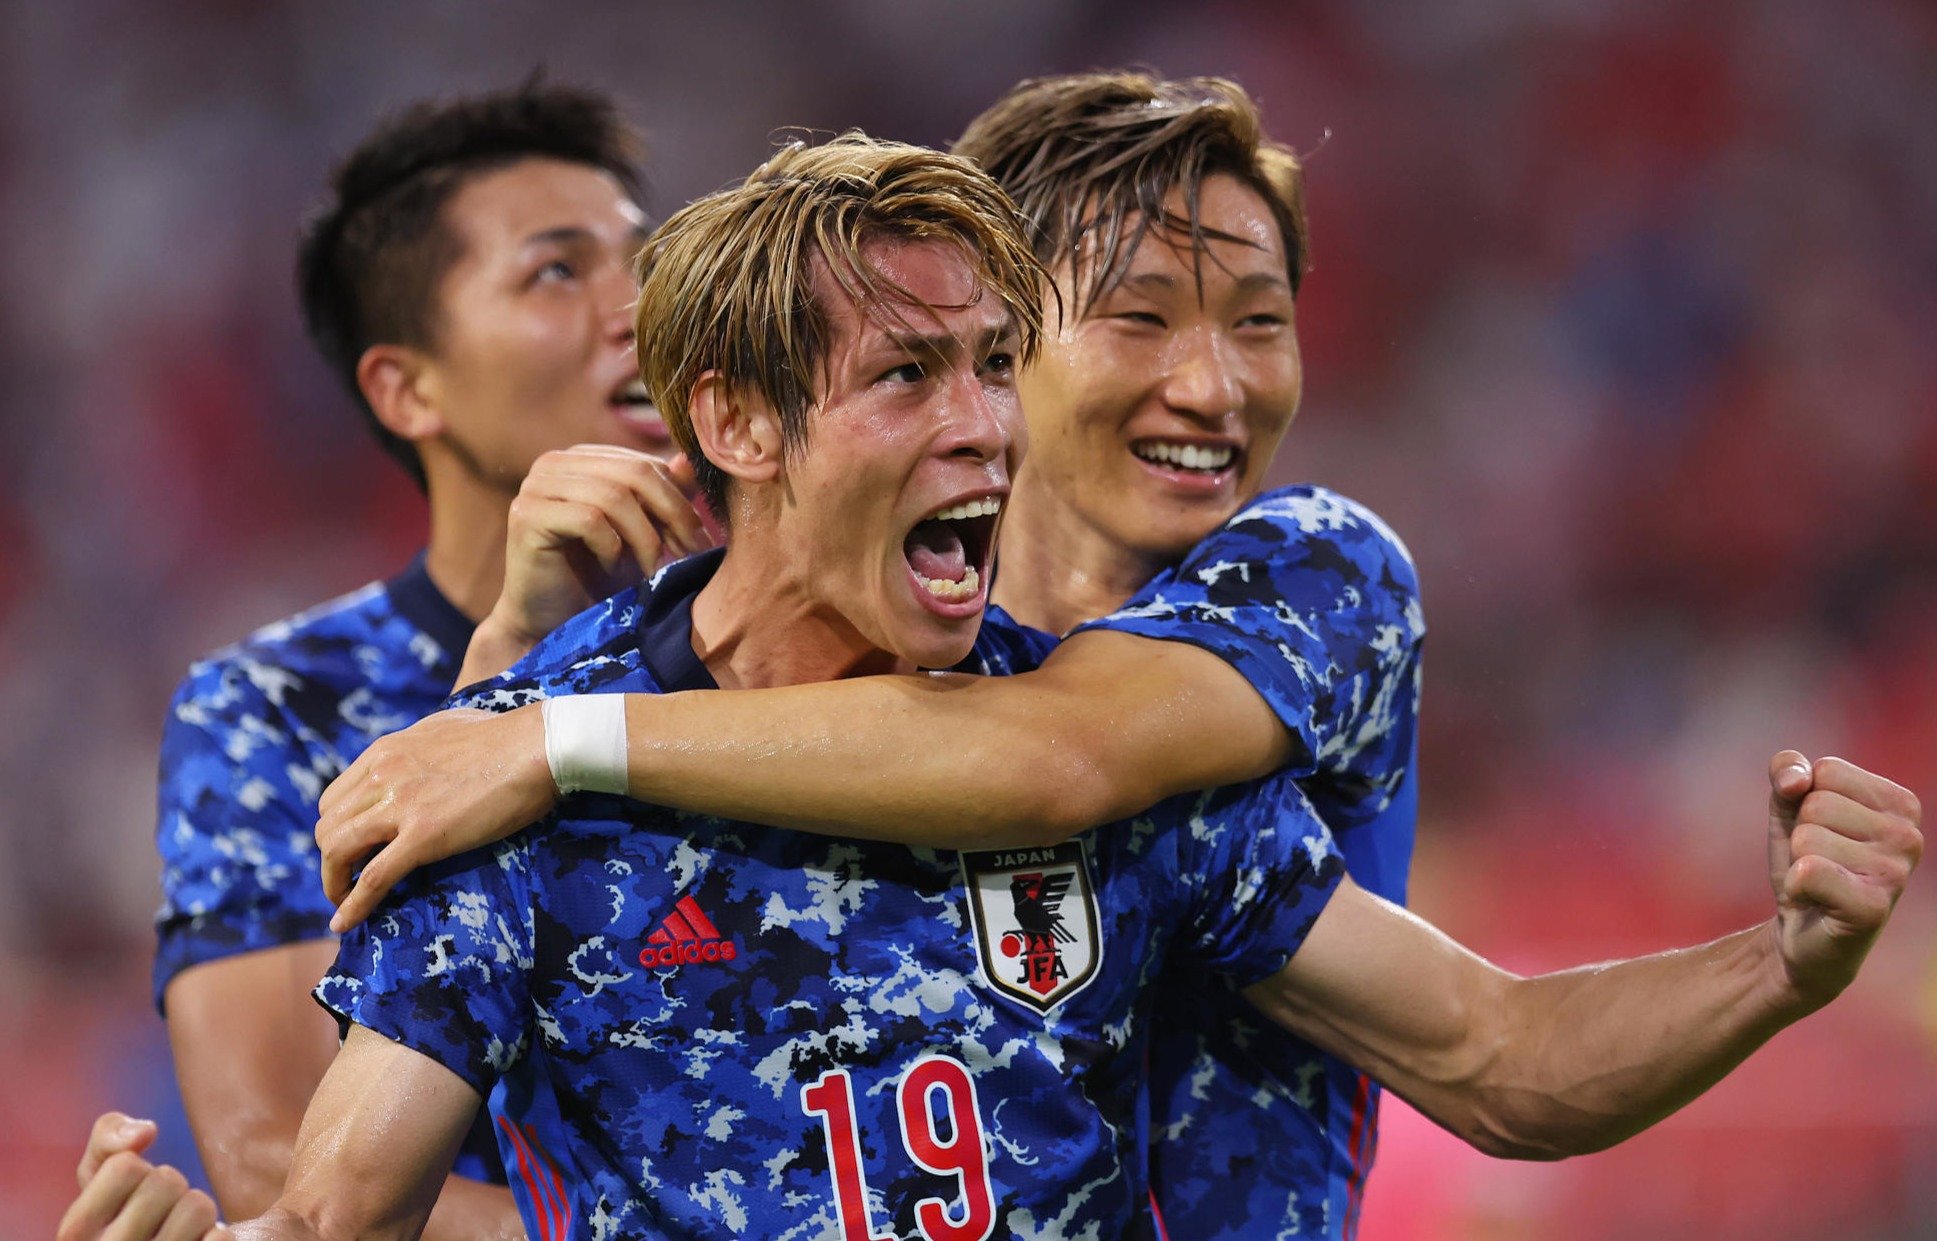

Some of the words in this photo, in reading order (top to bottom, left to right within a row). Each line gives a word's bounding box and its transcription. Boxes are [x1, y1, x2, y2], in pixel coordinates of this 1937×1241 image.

[994, 849, 1056, 867] JAPAN
[639, 938, 736, 967] adidas
[1017, 955, 1068, 984] JFA
[801, 1055, 996, 1241] 19
